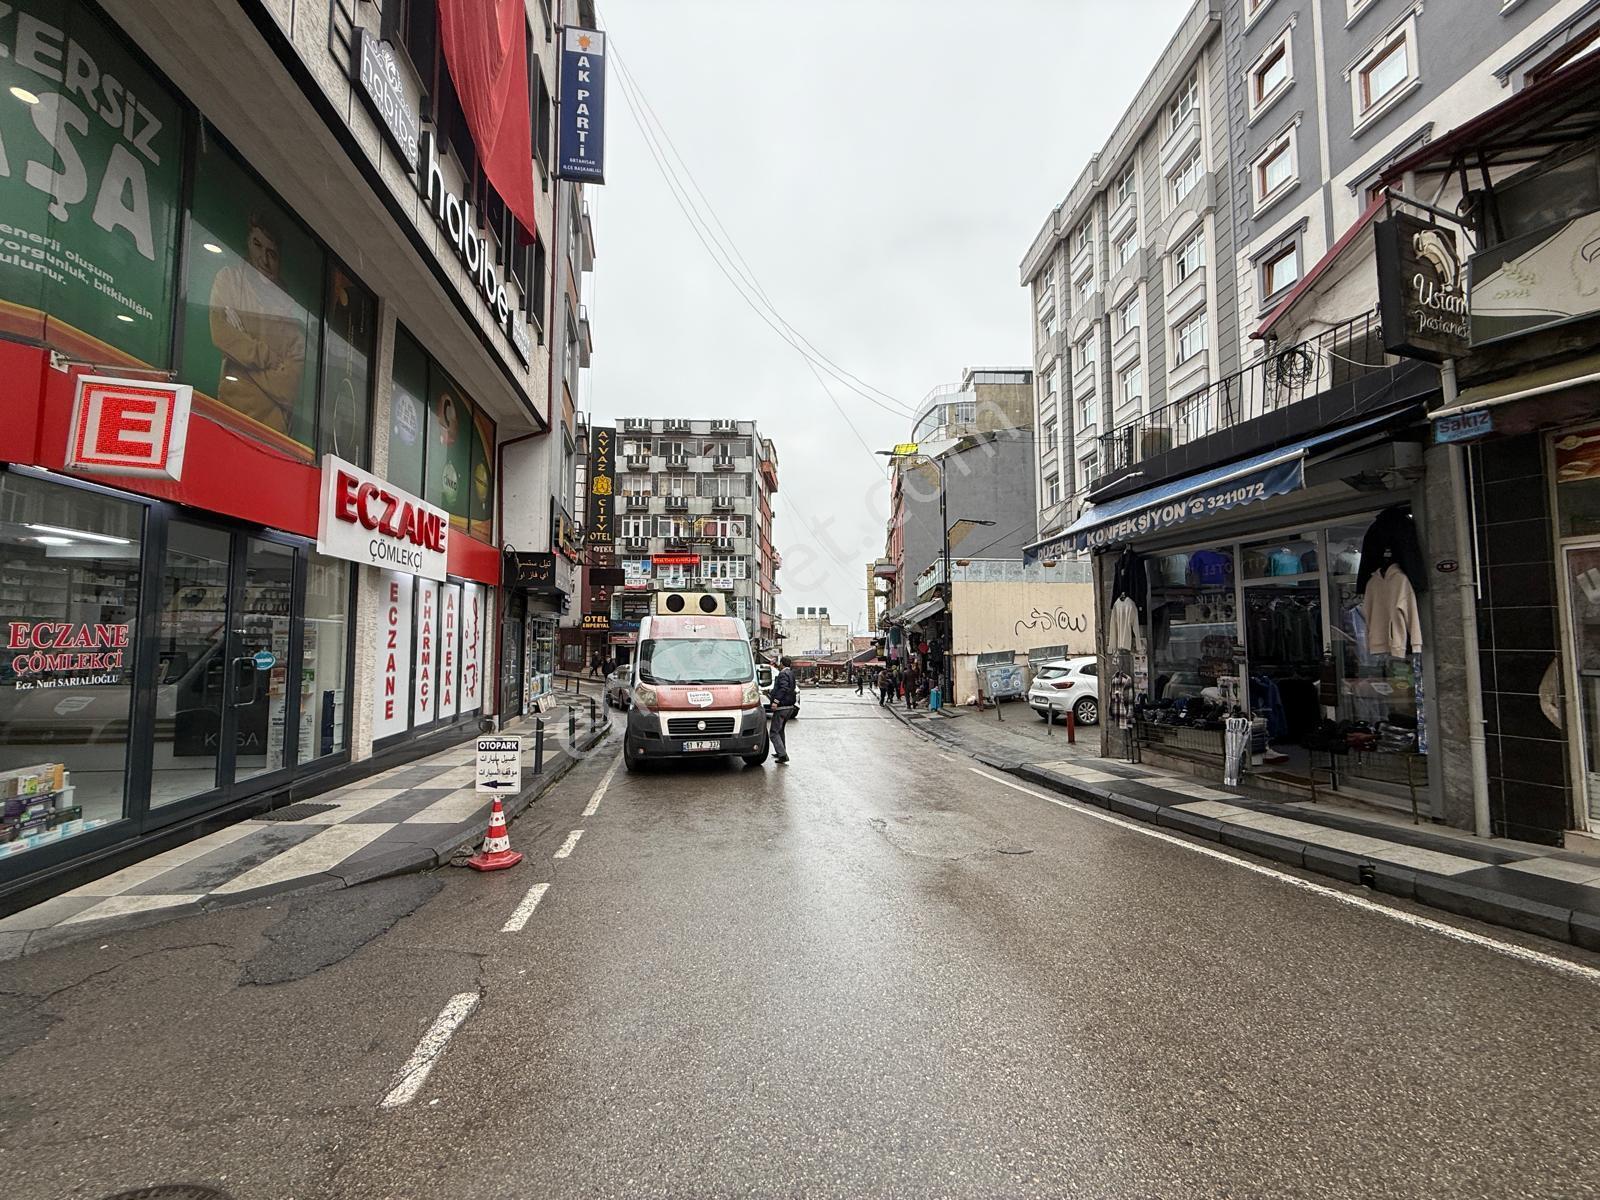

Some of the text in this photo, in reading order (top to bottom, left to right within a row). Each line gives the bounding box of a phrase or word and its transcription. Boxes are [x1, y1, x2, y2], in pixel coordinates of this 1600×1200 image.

[427, 130, 510, 325] habibe
[64, 249, 115, 285] oluşum
[597, 430, 609, 472] AYVAZ
[1206, 482, 1265, 509] 3211072
[335, 468, 448, 554] ECZANE
[589, 531, 612, 541] OTEL
[593, 545, 613, 553] OTEL
[369, 538, 423, 573] ÇÖMLEKÇİ
[583, 615, 609, 623] OTEL
[7, 621, 130, 650] ECZANE
[12, 648, 123, 677] ÇÖMLEKÇİ
[384, 582, 399, 720] ECZANE
[420, 589, 432, 712] PHARMACY
[36, 676, 57, 689] Nuri
[479, 741, 518, 751] OTOPARK
